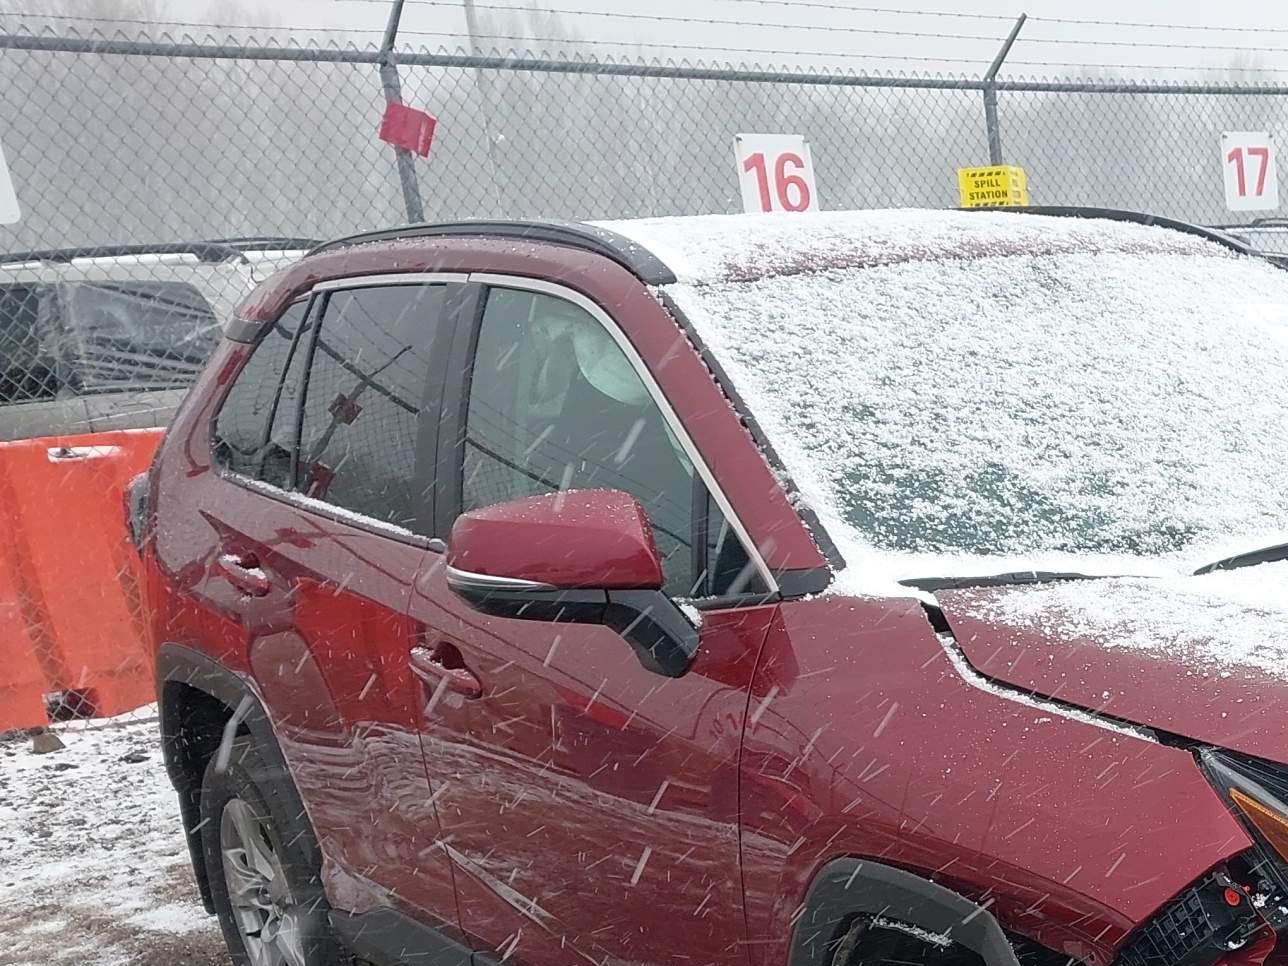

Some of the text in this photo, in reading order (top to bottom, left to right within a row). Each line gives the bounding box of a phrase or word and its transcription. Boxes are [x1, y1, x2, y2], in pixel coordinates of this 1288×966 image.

[743, 152, 811, 213] 16
[973, 179, 1001, 189] SPILL
[1228, 147, 1269, 197] 17
[968, 189, 1008, 201] STATION
